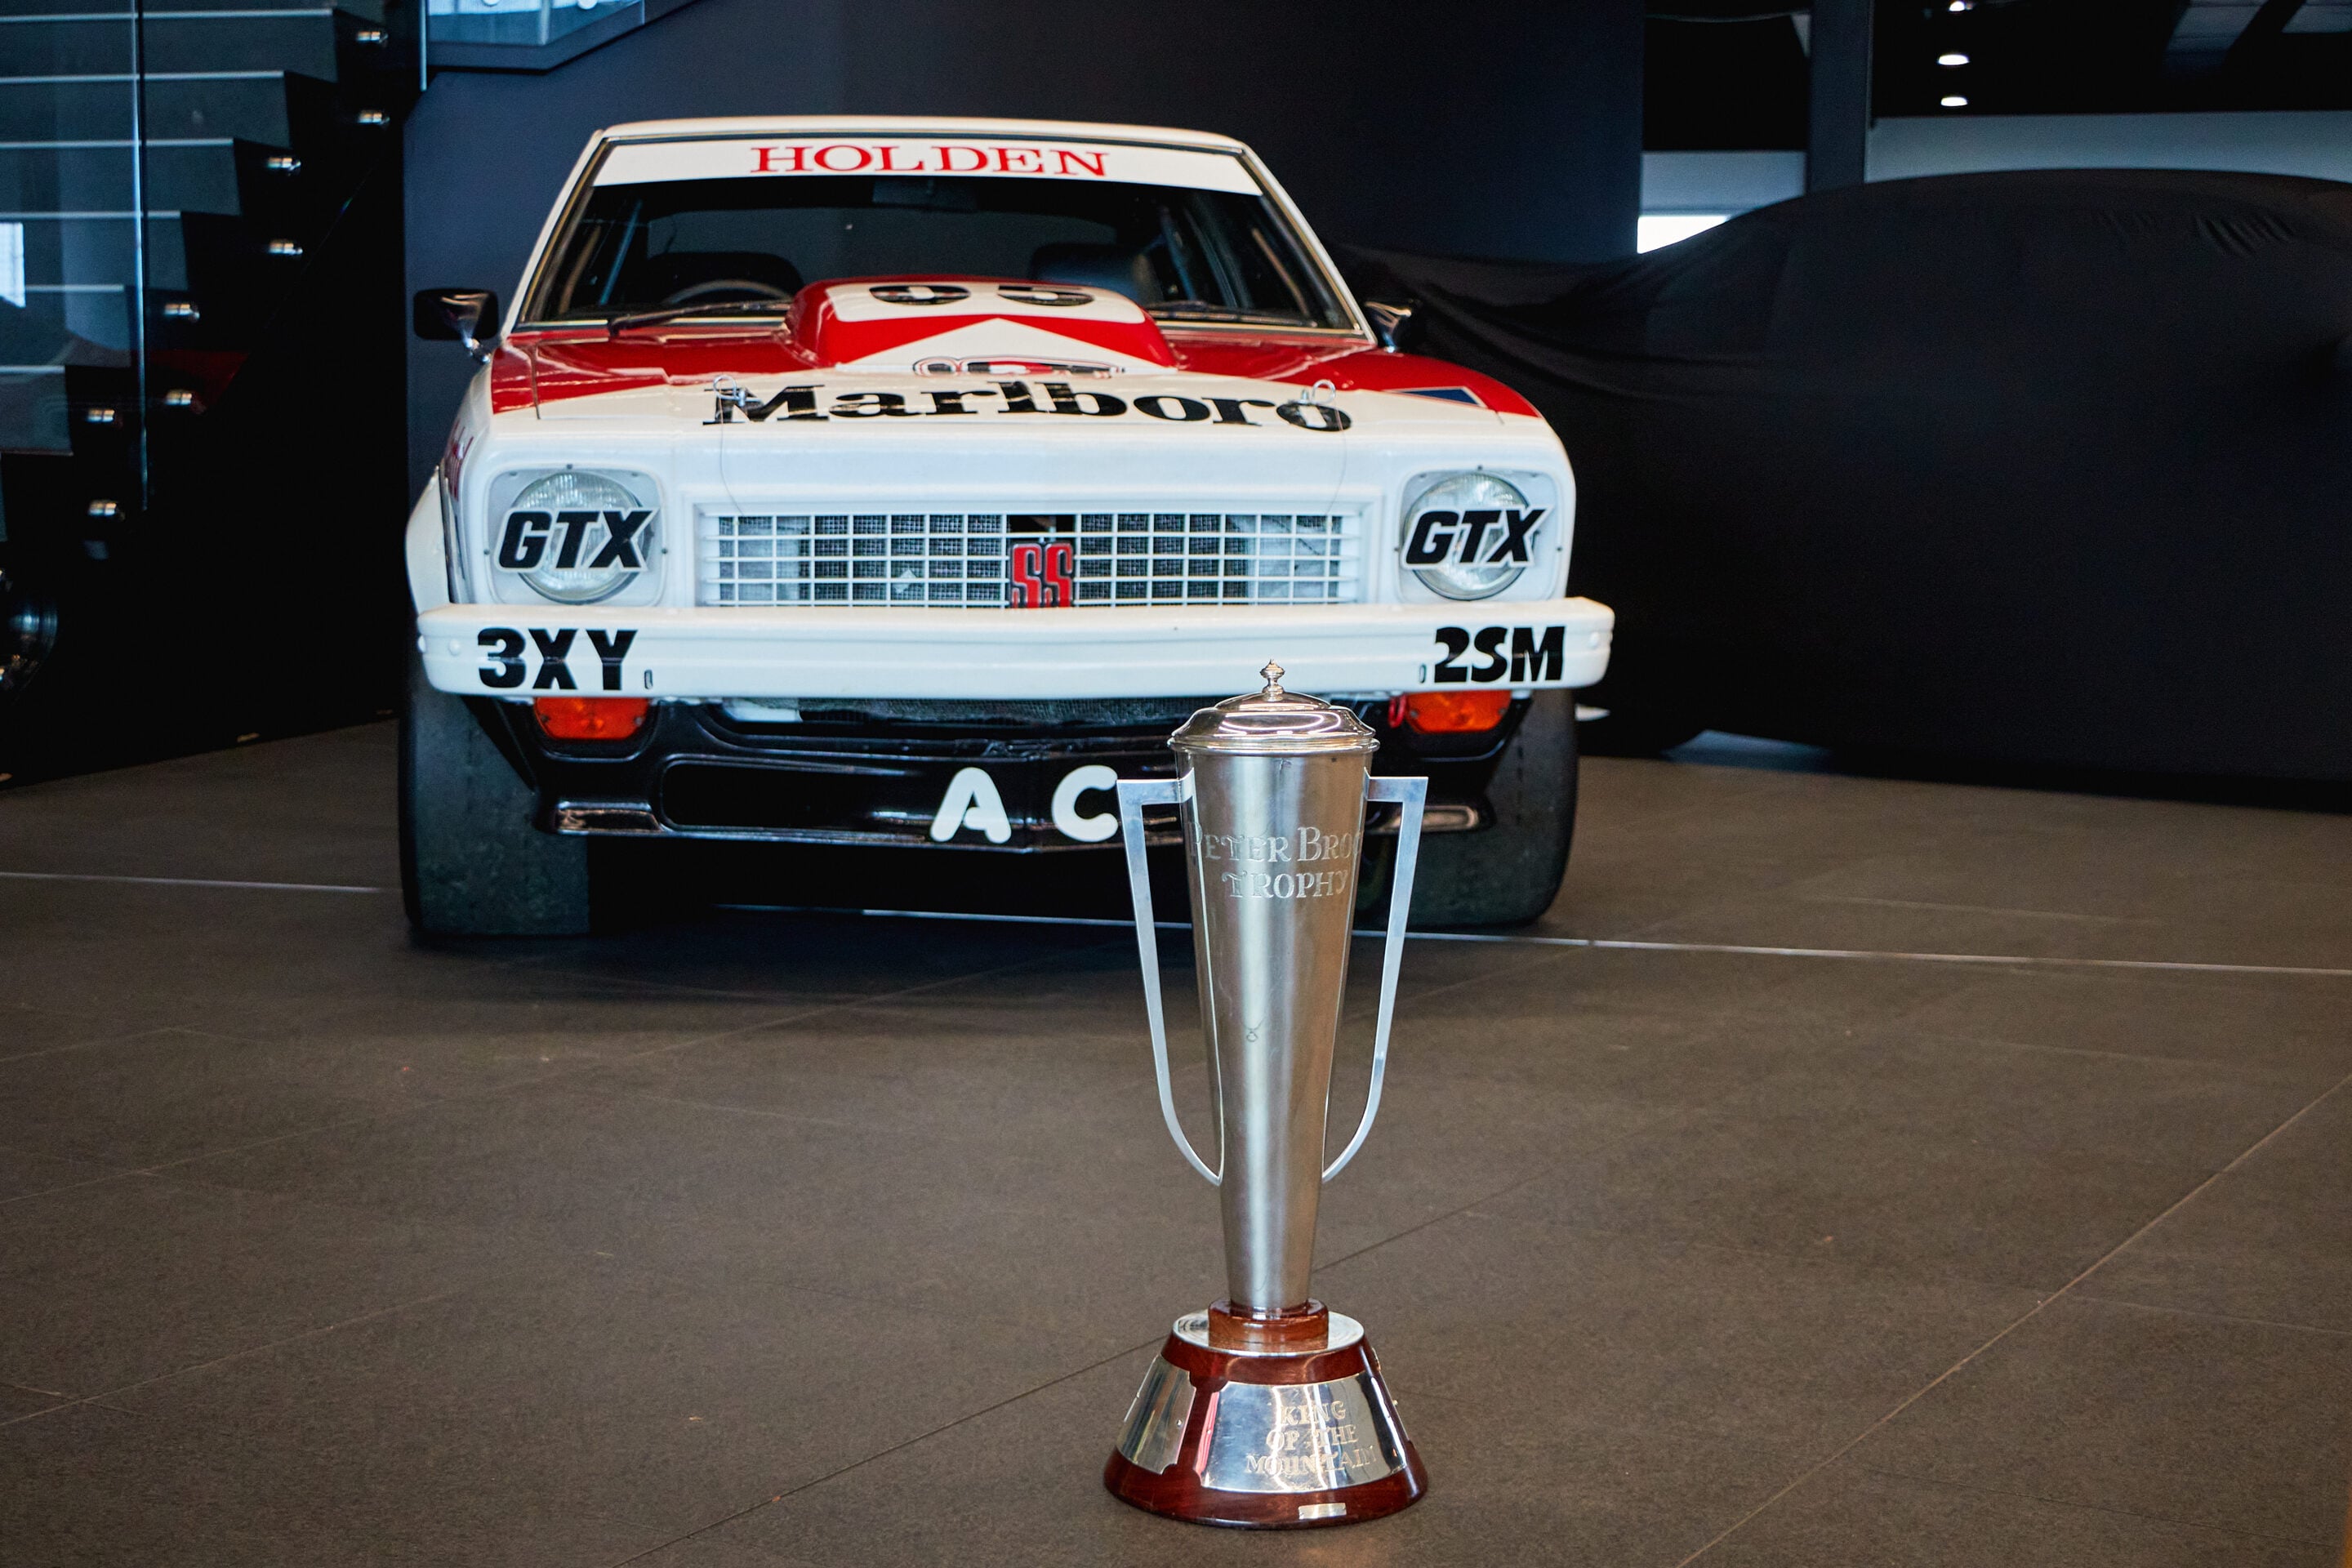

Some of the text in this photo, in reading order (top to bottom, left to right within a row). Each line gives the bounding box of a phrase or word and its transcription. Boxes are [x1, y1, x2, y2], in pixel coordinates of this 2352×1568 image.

[751, 145, 1109, 176] HOLDEN
[702, 381, 1352, 432] Marlboro
[498, 510, 653, 569] GTX
[1405, 508, 1548, 564] GTX
[1012, 543, 1073, 608] SS
[477, 627, 639, 691] 3XY
[1434, 626, 1566, 684] 2SM
[1222, 870, 1348, 898] TROPHY
[1280, 1400, 1346, 1426] KING
